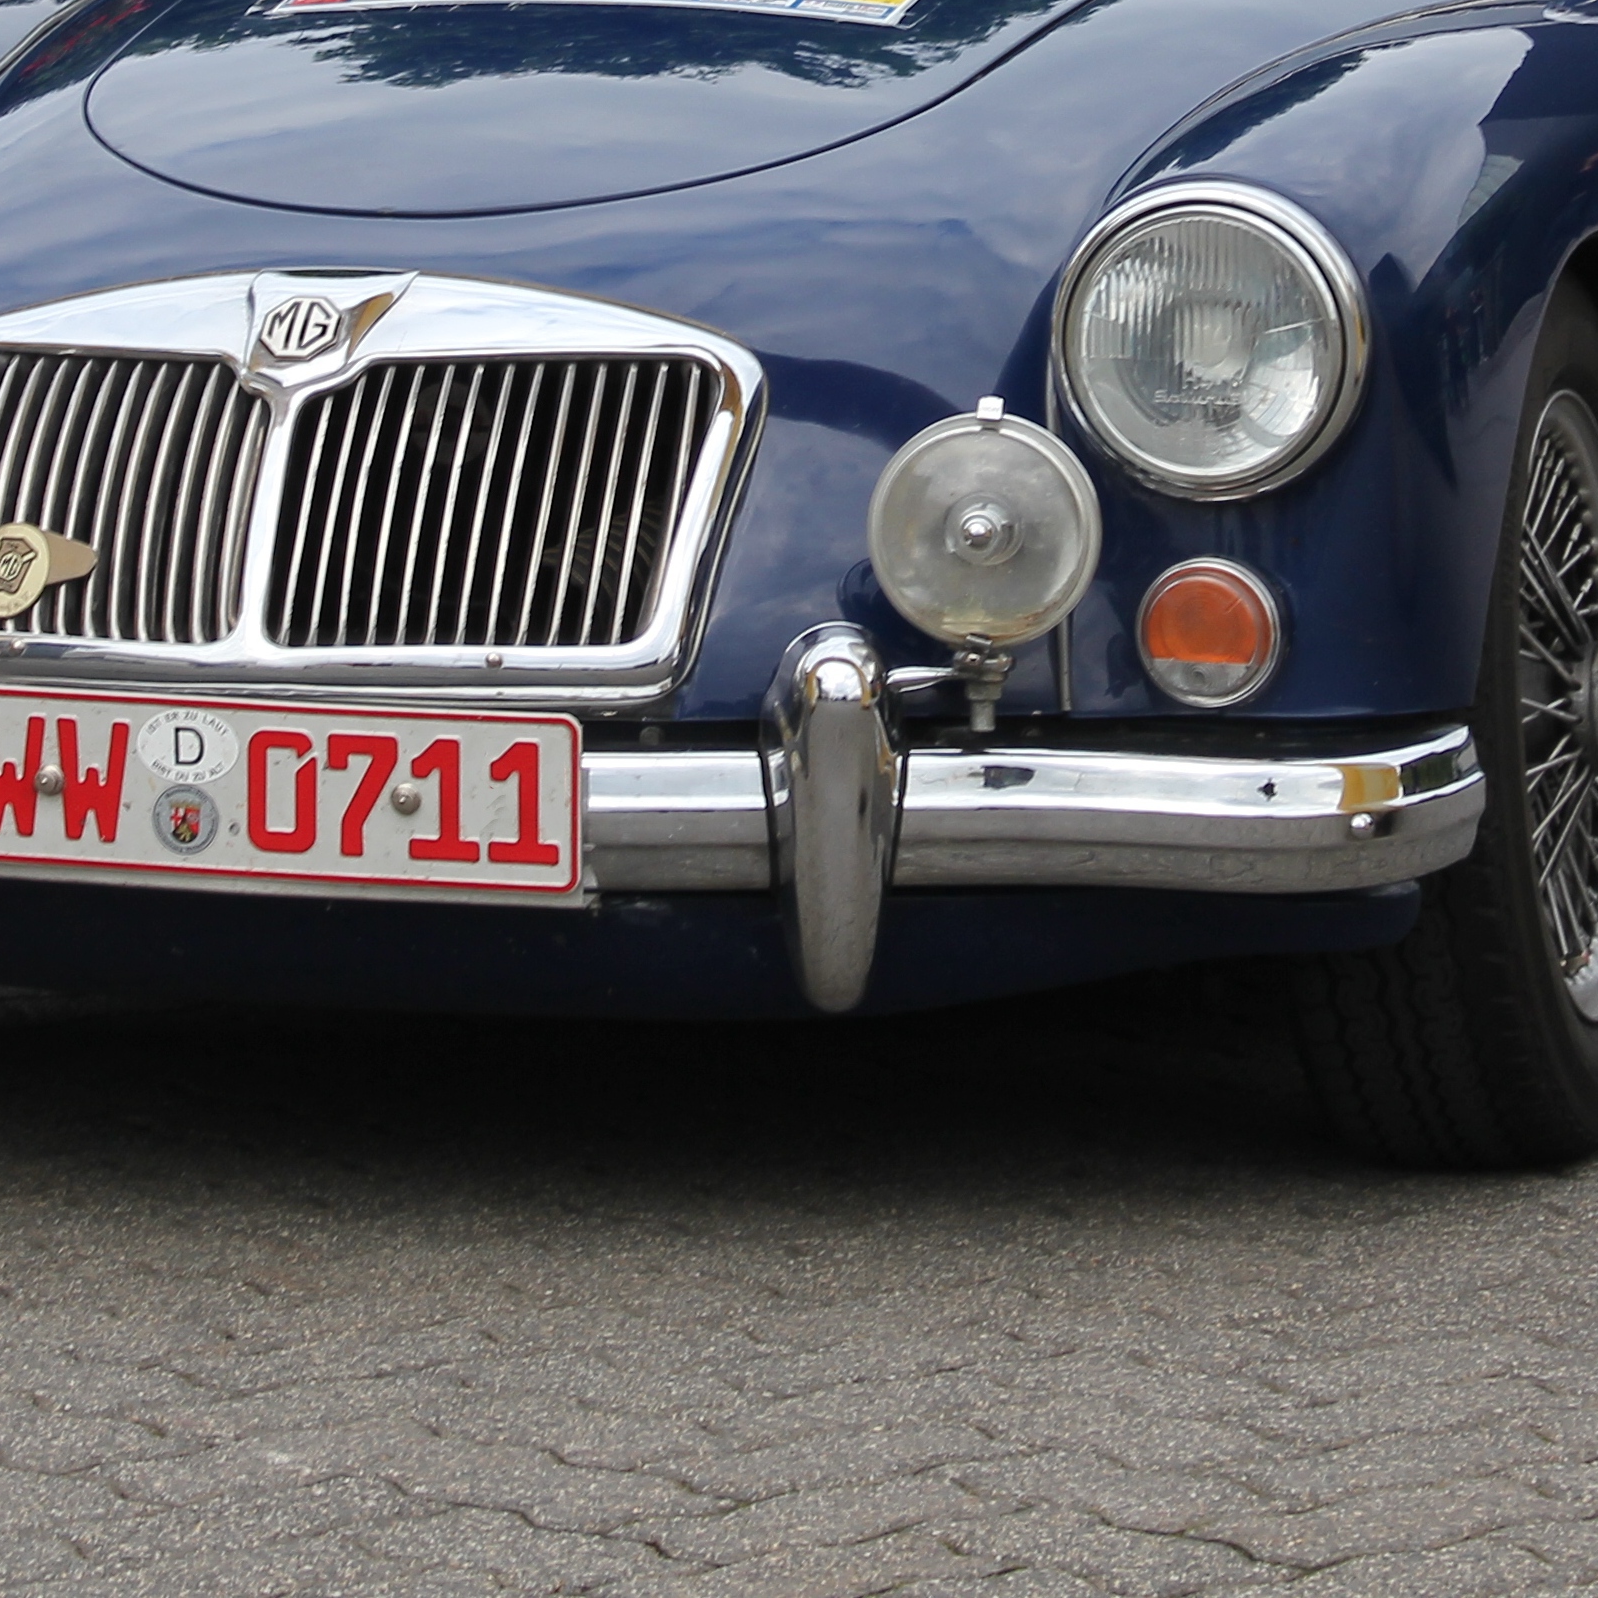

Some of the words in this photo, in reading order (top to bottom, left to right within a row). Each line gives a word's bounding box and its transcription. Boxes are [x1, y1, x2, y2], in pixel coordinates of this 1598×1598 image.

[268, 301, 333, 350] MG
[175, 727, 204, 766] D
[201, 713, 231, 737] LAUT
[246, 729, 560, 865] 0711
